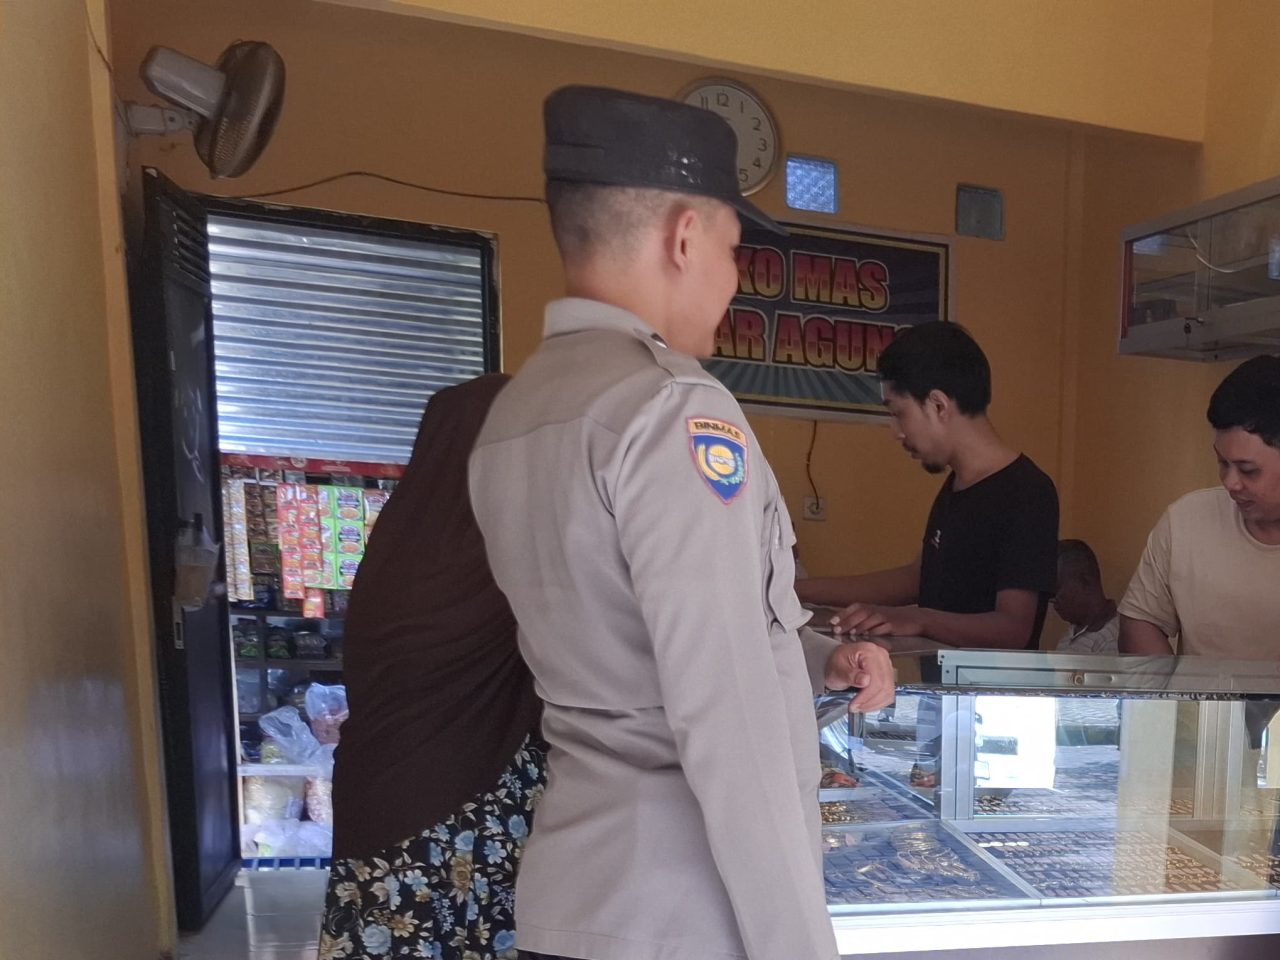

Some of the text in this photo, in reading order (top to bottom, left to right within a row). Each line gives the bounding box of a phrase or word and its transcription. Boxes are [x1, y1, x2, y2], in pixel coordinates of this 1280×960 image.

[717, 92, 729, 108] 12
[752, 117, 761, 131] 2
[757, 138, 767, 152] 3
[752, 157, 762, 169] 4
[739, 168, 749, 183] 5
[791, 250, 889, 311] MAS
[771, 312, 908, 374] AGUN
